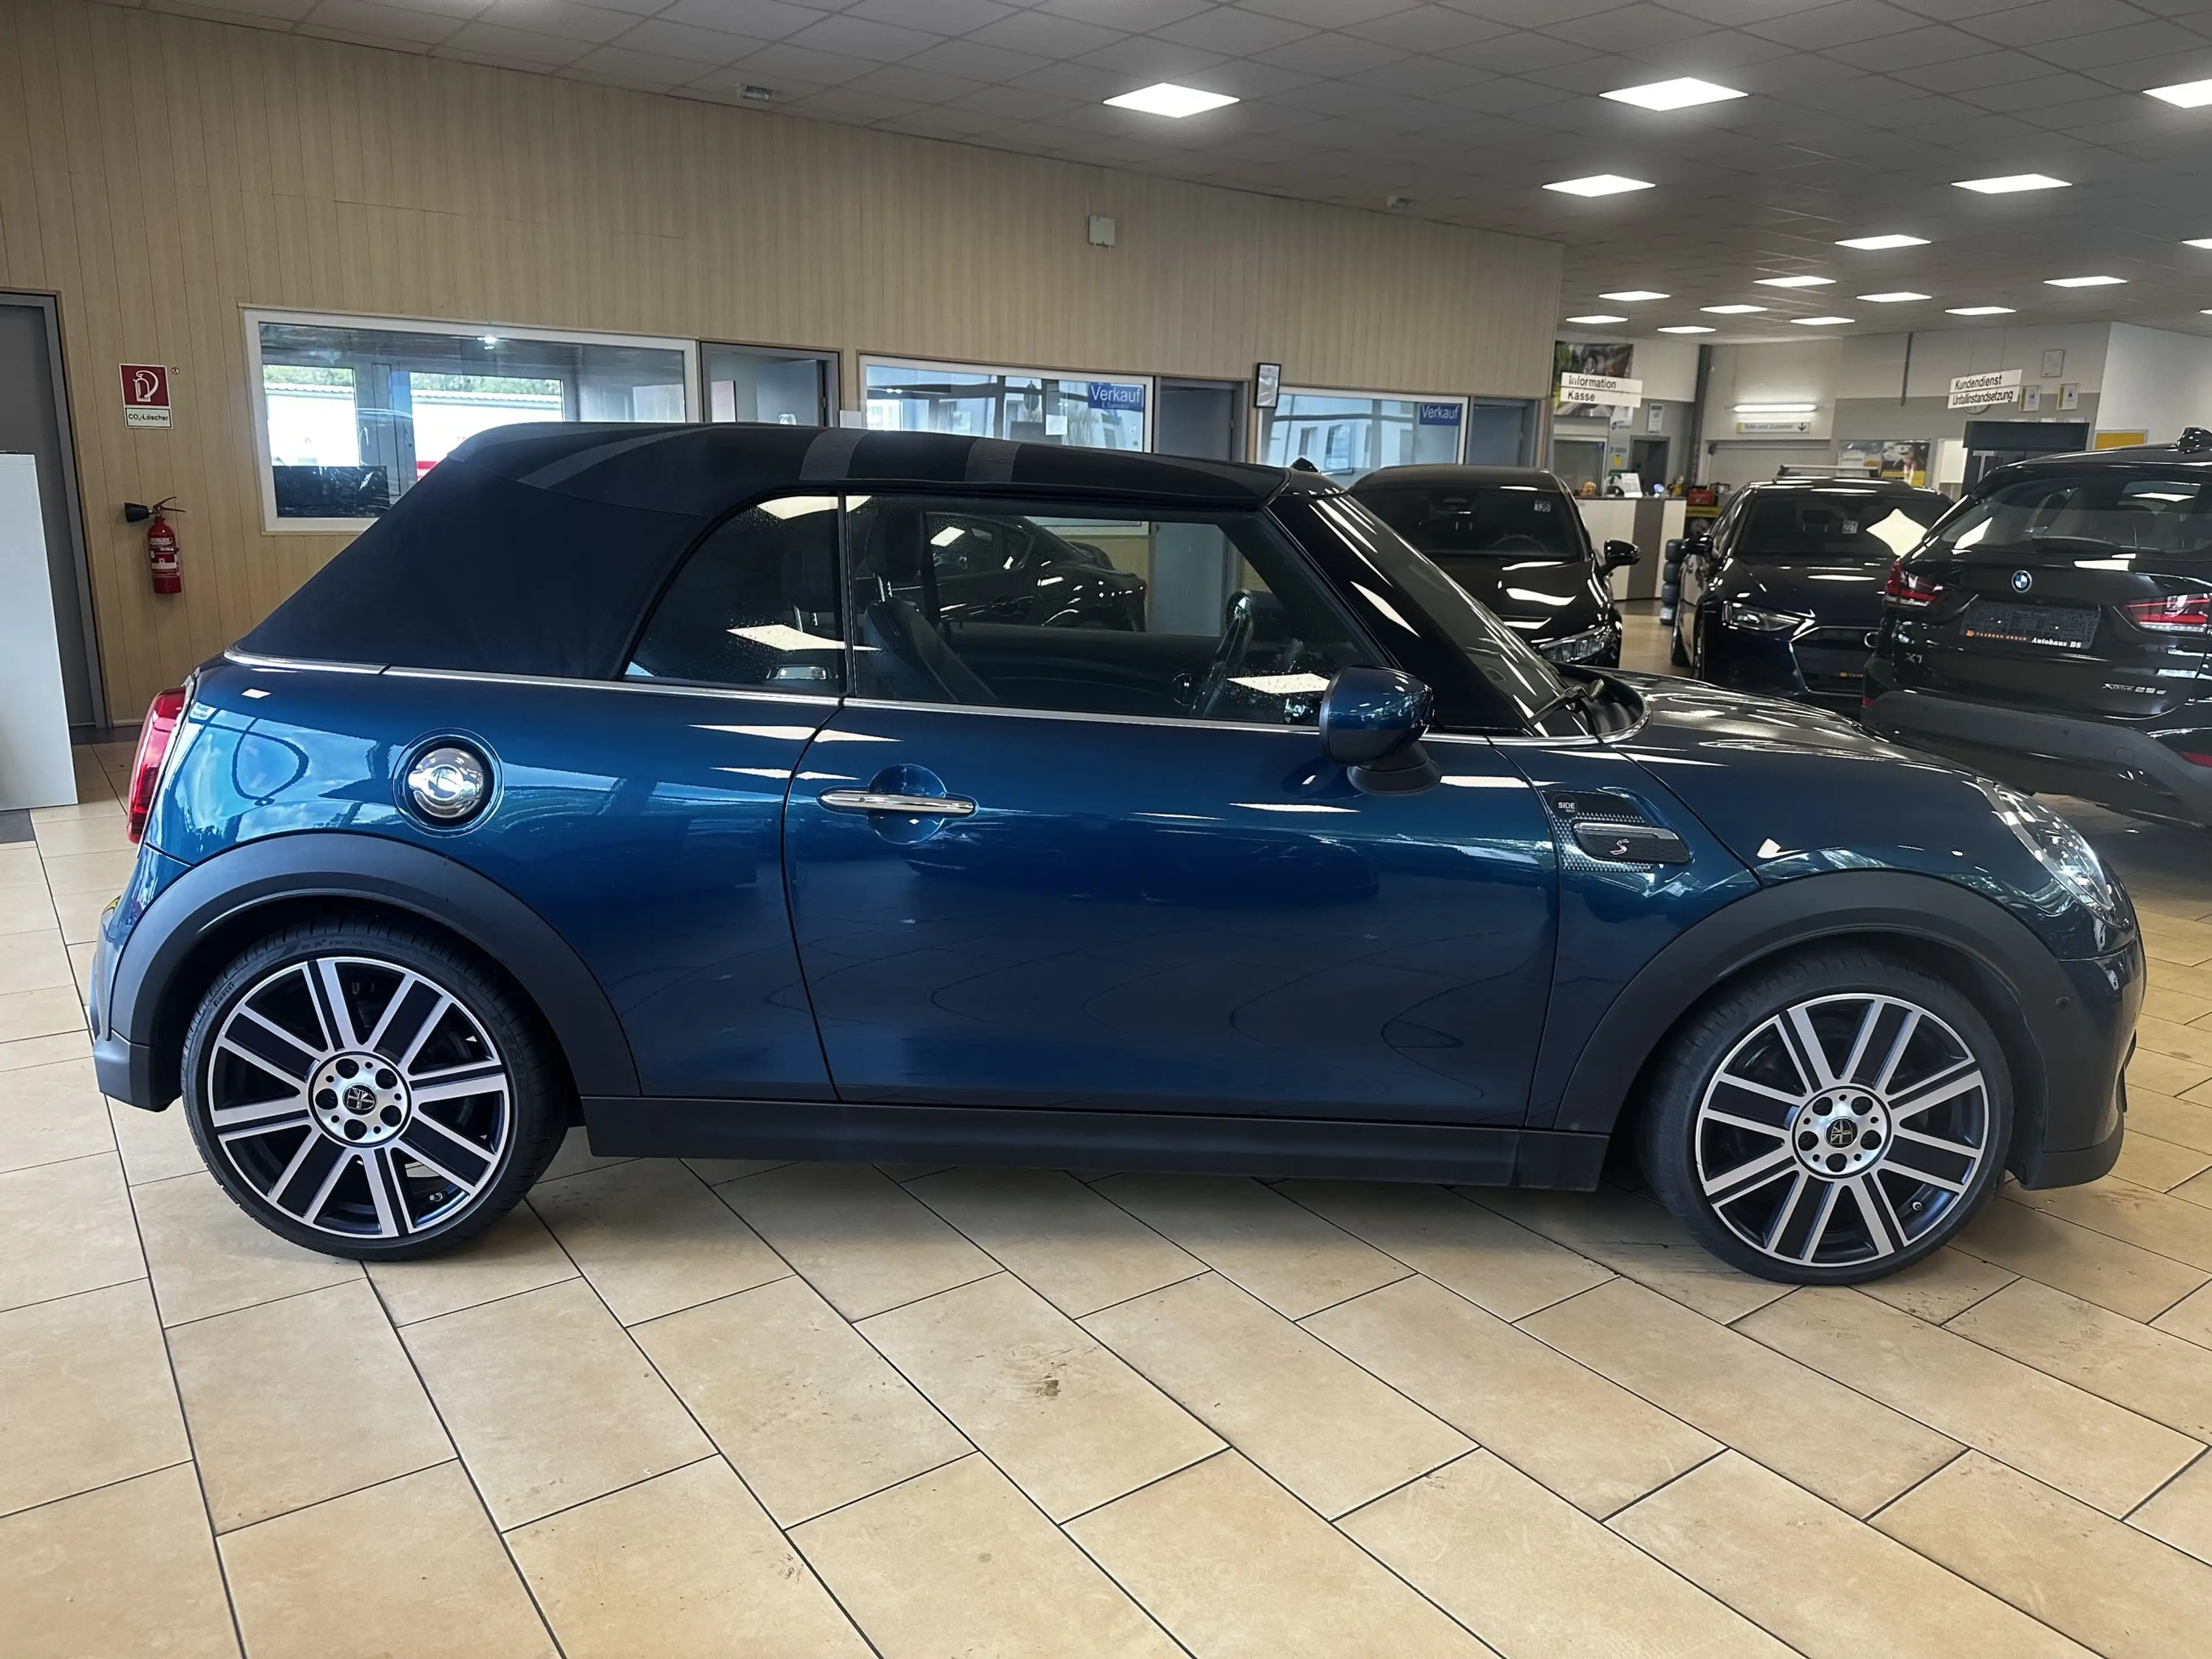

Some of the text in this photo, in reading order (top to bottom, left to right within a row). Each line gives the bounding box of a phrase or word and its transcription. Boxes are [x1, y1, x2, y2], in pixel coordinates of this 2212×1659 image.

[1569, 375, 1616, 389] Information
[1955, 375, 2002, 390] Kundendienst
[1090, 384, 1141, 403] Verkauf
[1567, 390, 1595, 402] Kasse
[1952, 391, 2013, 406] Unfallinstandsetzung
[1422, 405, 1459, 419] Verkauf
[2031, 637, 2067, 646] Autohaus
[1906, 652, 1922, 664] X1
[1610, 839, 1630, 855] S
[213, 981, 235, 1008] PIRELLI
